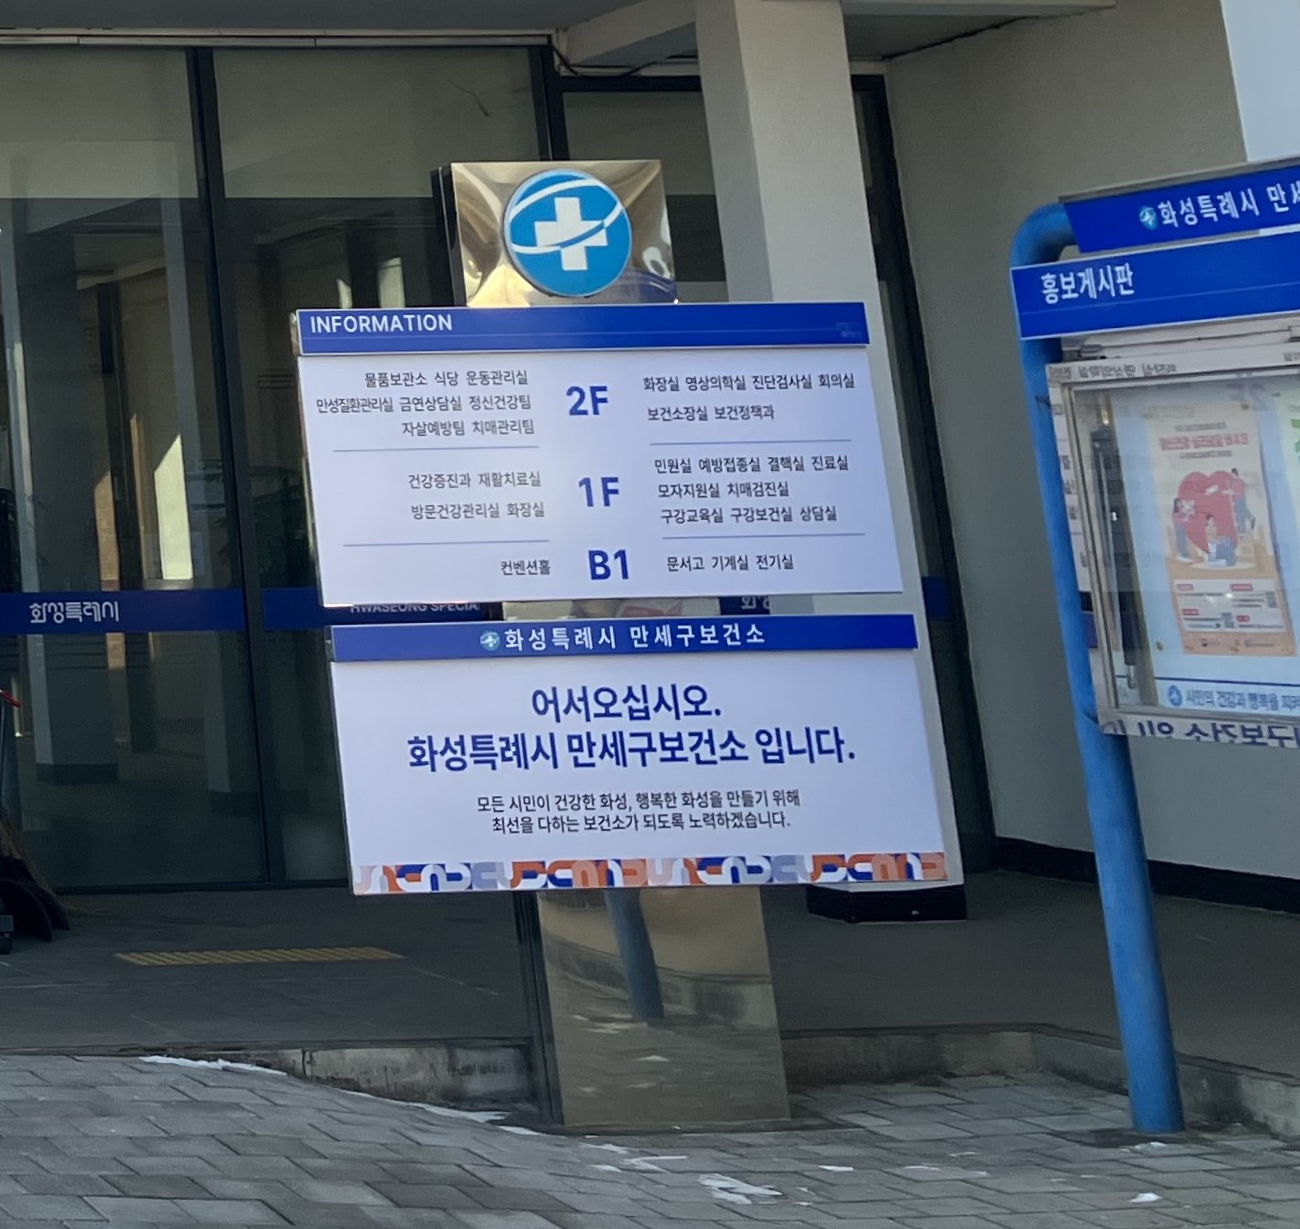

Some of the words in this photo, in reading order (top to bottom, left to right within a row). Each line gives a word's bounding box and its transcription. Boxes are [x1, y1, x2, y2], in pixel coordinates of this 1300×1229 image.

[1158, 188, 1259, 227] 화성특례시
[1040, 262, 1134, 304] 홍보게시판
[311, 314, 452, 333] INFORMATION
[365, 373, 427, 387] 물품보관소
[434, 372, 458, 386] 식당
[467, 370, 528, 385] 운동관리실
[643, 377, 679, 391] 화장실
[686, 376, 746, 391] 영상의학실
[753, 374, 812, 389] 진단검사실
[819, 373, 854, 388] 회의실
[317, 398, 393, 413] 만성질환관리실
[400, 396, 462, 412] 금연상담실
[469, 395, 531, 410] 정신건강팀
[567, 386, 608, 415] 2F
[648, 406, 708, 421] 보건소장실
[715, 405, 774, 420] 보건정책과
[402, 421, 464, 436] 자살예방팀
[473, 419, 534, 434] 치매관리팀
[655, 458, 691, 474] 민원실
[699, 457, 761, 473] 예방접종실
[768, 457, 804, 471] 결핵실
[812, 456, 848, 471] 진료실
[409, 473, 471, 489] 건강증진과
[478, 472, 541, 487] 재활치료실
[579, 477, 619, 507] 1F
[659, 483, 720, 498] 모자지원실
[728, 482, 789, 497] 치매검진실
[411, 504, 500, 520] 방문건강관리실
[507, 502, 544, 517] 화장실
[661, 508, 723, 524] 구강교육실
[731, 507, 792, 522] 구강보건실
[800, 506, 837, 521] 상담실
[501, 560, 550, 575] 컨벤션홀
[589, 550, 628, 580] B1
[667, 556, 704, 571] 문서고
[712, 555, 748, 570] 기계실
[756, 555, 793, 570] 전기실
[29, 600, 120, 625] 화성특례시
[505, 627, 616, 651] 화성특례시
[630, 623, 765, 648] 만세구보건소
[533, 684, 721, 723] 어서오십시오.
[408, 732, 558, 772] 화성특례시
[567, 729, 748, 768] 만세구보건소
[756, 727, 855, 764] 입니다.
[478, 796, 504, 812] 모든
[510, 795, 550, 812] 시민이
[555, 794, 595, 811] 건강한
[600, 793, 631, 812] 화성,
[635, 791, 677, 810] 행복한
[681, 791, 722, 808] 화성을
[727, 790, 768, 807] 만들기
[773, 790, 800, 806] 위해
[493, 817, 533, 834] 최선을
[538, 816, 579, 833] 다하는
[584, 813, 638, 831] 보건소가
[644, 813, 684, 830] 되도록
[689, 811, 790, 829] 노력하겠습니다.
